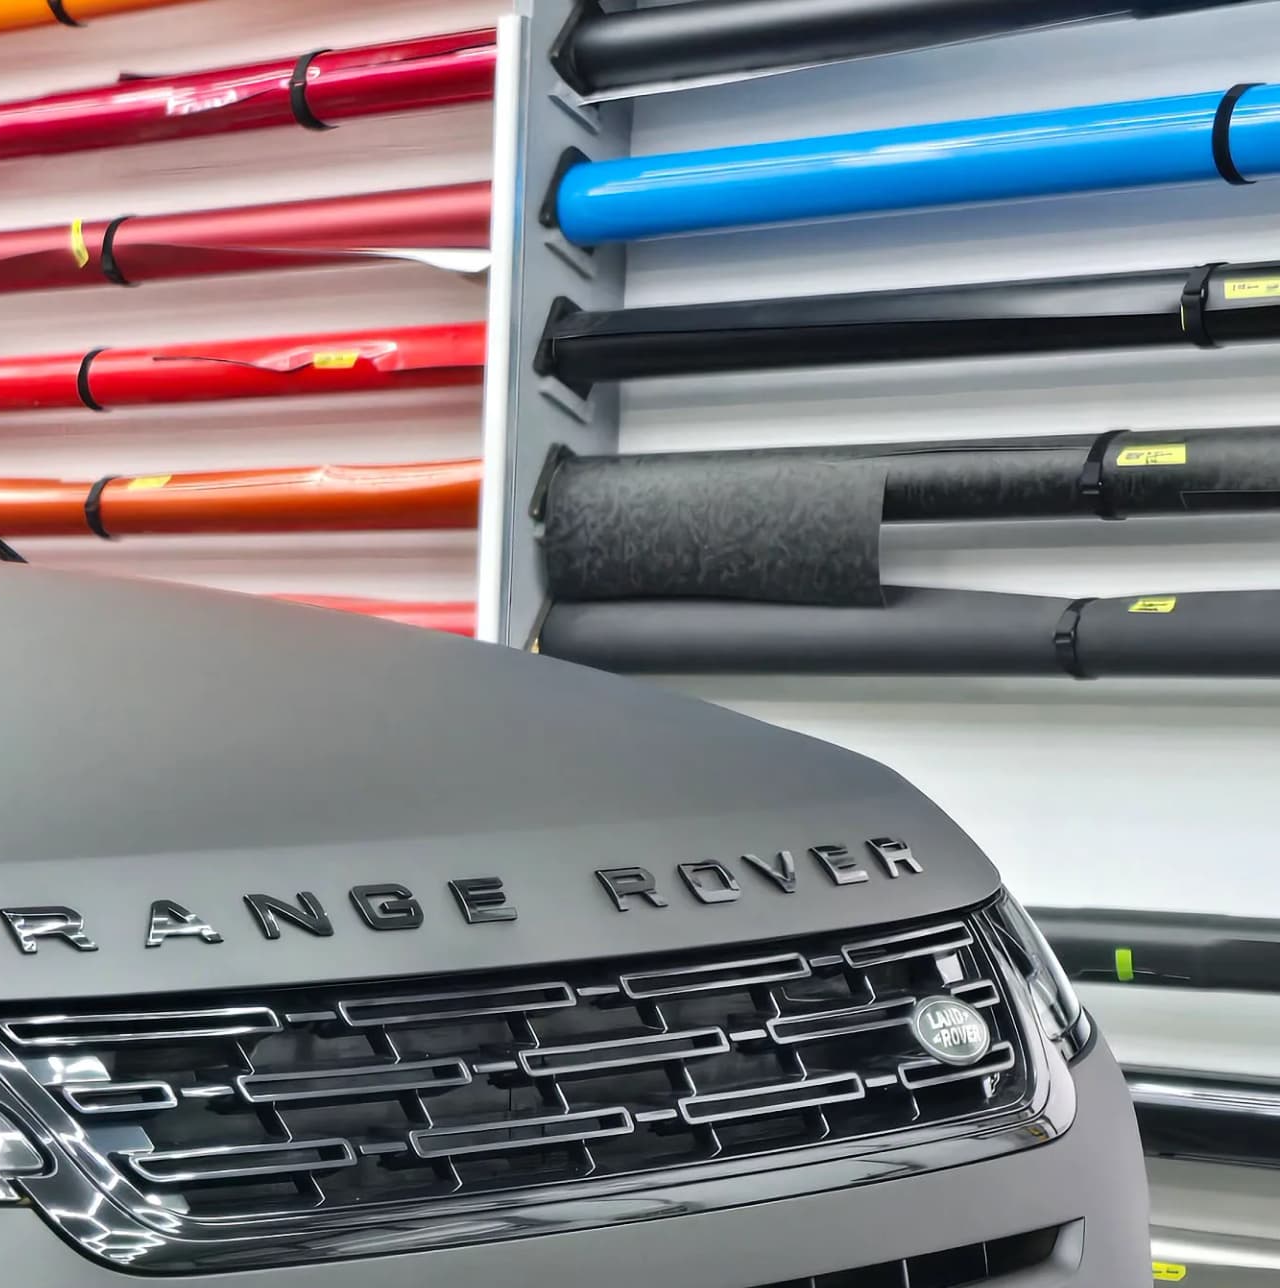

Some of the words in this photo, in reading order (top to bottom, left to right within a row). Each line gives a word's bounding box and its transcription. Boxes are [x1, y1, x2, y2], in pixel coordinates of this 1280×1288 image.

[0, 873, 517, 956] RANGE
[593, 836, 926, 912] ROVER
[927, 1007, 963, 1029] LAND
[941, 1024, 982, 1048] ROVER
